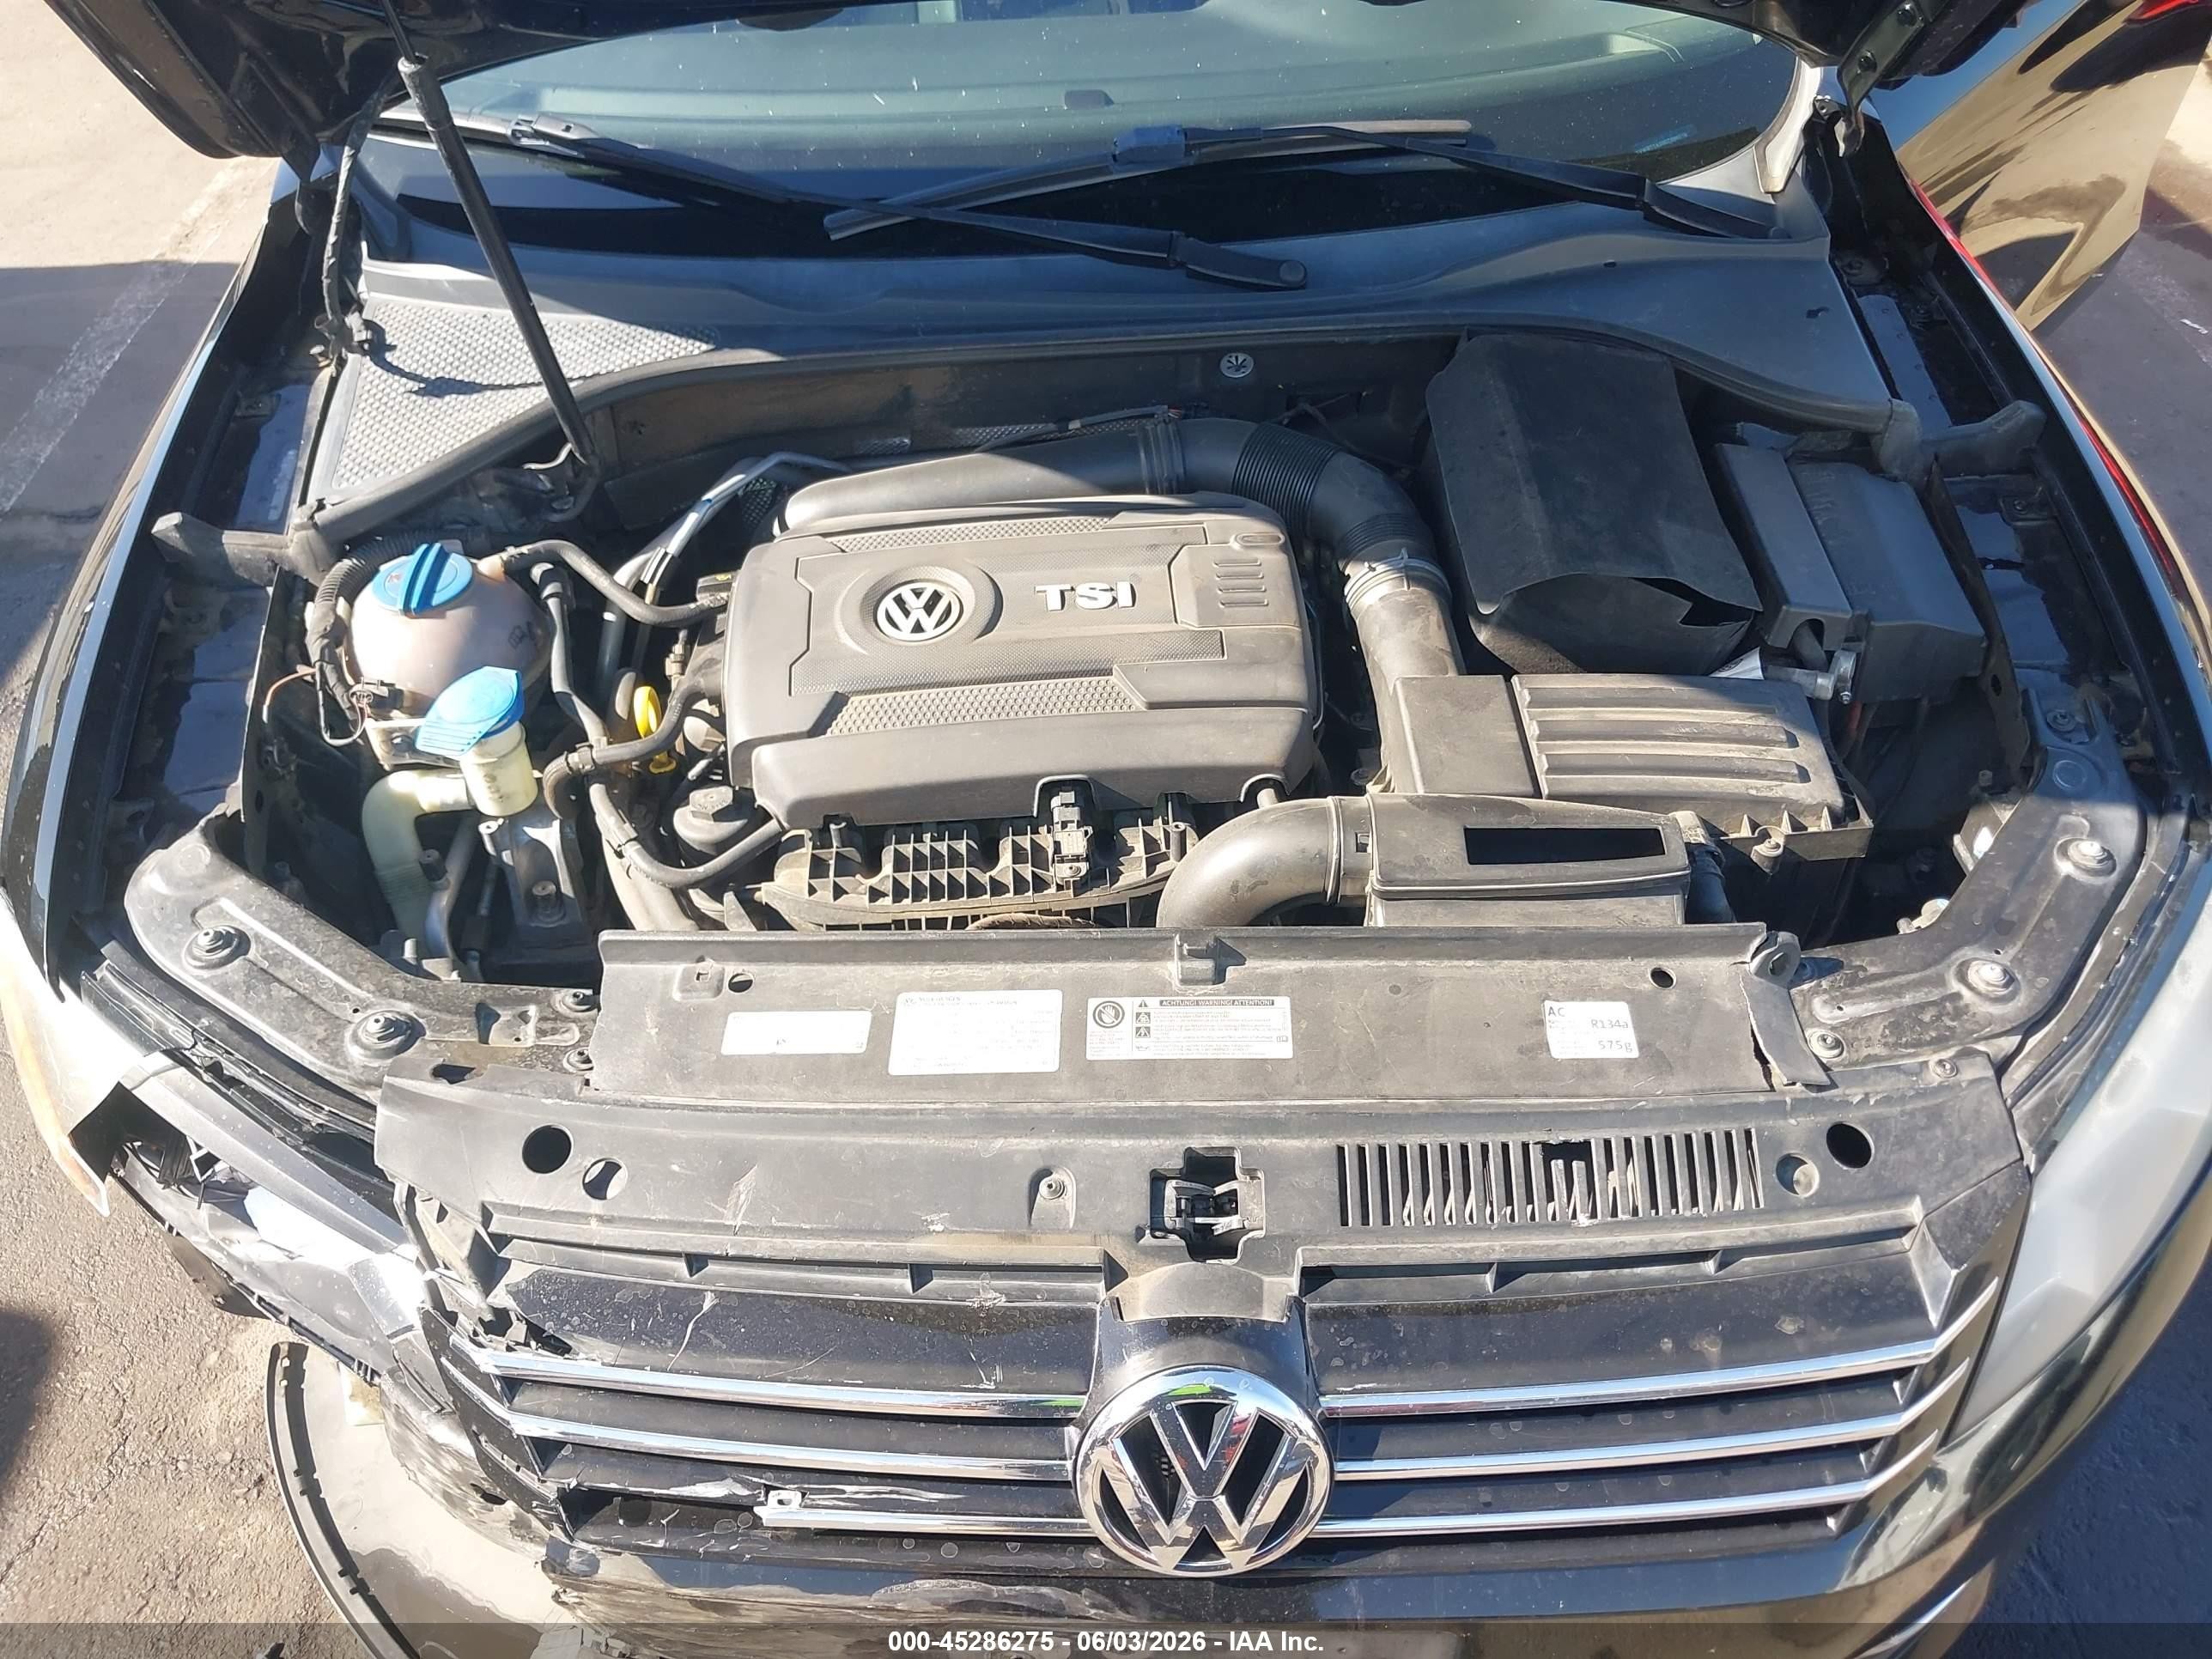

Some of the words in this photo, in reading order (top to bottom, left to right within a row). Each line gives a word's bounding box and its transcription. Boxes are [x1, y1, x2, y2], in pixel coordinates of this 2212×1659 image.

[1034, 581, 1134, 611] TSI
[877, 582, 960, 641] VW
[1547, 1006, 1565, 1018] AC
[1590, 1018, 1629, 1029] R134a
[1075, 1365, 1334, 1577] VW
